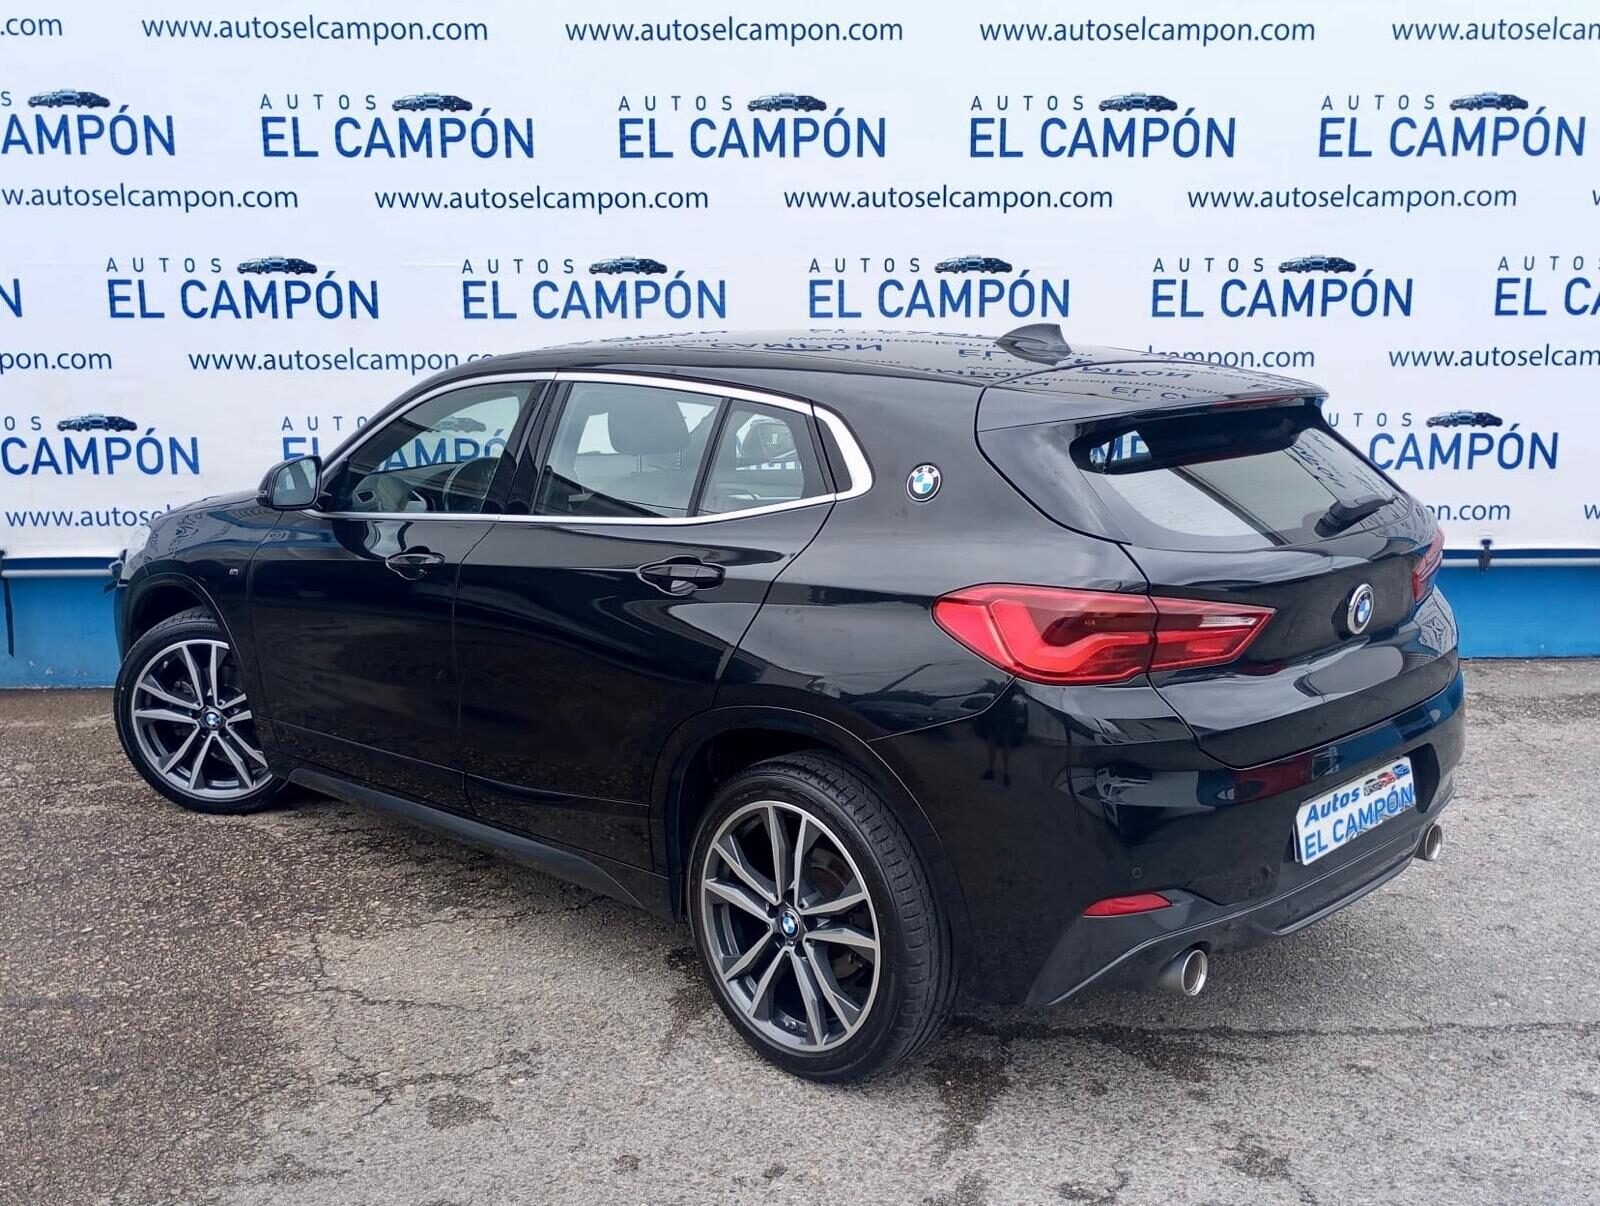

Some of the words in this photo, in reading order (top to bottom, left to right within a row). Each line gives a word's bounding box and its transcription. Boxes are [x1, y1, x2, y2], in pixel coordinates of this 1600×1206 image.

[141, 15, 488, 46] www.autoselcampon.com
[565, 15, 903, 47] www.autoselcampon.com
[979, 15, 1315, 47] www.autoselcampon.com
[260, 93, 377, 110] AUTOS
[618, 95, 733, 111] AUTOS
[970, 95, 1084, 111] AUTOS
[1321, 94, 1435, 110] AUTOS
[261, 116, 319, 158] EL
[334, 107, 534, 158] CAMPÓN
[618, 117, 674, 158] EL
[690, 107, 886, 158] CAMPÓN
[969, 117, 1024, 158] EL
[1040, 107, 1236, 158] CAMPÓN
[1318, 116, 1372, 158] EL
[1389, 106, 1586, 157] CAMPÓN
[374, 184, 709, 215] www.autoselcampon.com
[783, 183, 1113, 213] www.autoselcampon.com
[1187, 183, 1517, 213] www.autoselcampon.com
[105, 257, 222, 273] AUTOS
[461, 258, 574, 274] AUTOS
[808, 257, 920, 273] AUTOS
[1152, 257, 1264, 273] AUTOS
[1497, 255, 1600, 272] AUTO
[107, 278, 166, 319] EL
[180, 271, 379, 319] CAMPÓN
[462, 280, 518, 319] EL
[532, 271, 726, 319] CAMPÓN
[809, 279, 862, 319] EL
[877, 270, 1070, 319] CAMPÓN
[1151, 278, 1205, 318] EL
[1220, 269, 1414, 318] CAMPÓN
[1494, 277, 1547, 316] EL
[1, 427, 200, 475] CAMPÓN
[1369, 423, 1559, 471] CAMPÓN
[1304, 787, 1360, 827] Autos
[1305, 829, 1328, 860] EL
[1333, 783, 1414, 843] CAMPÓN
